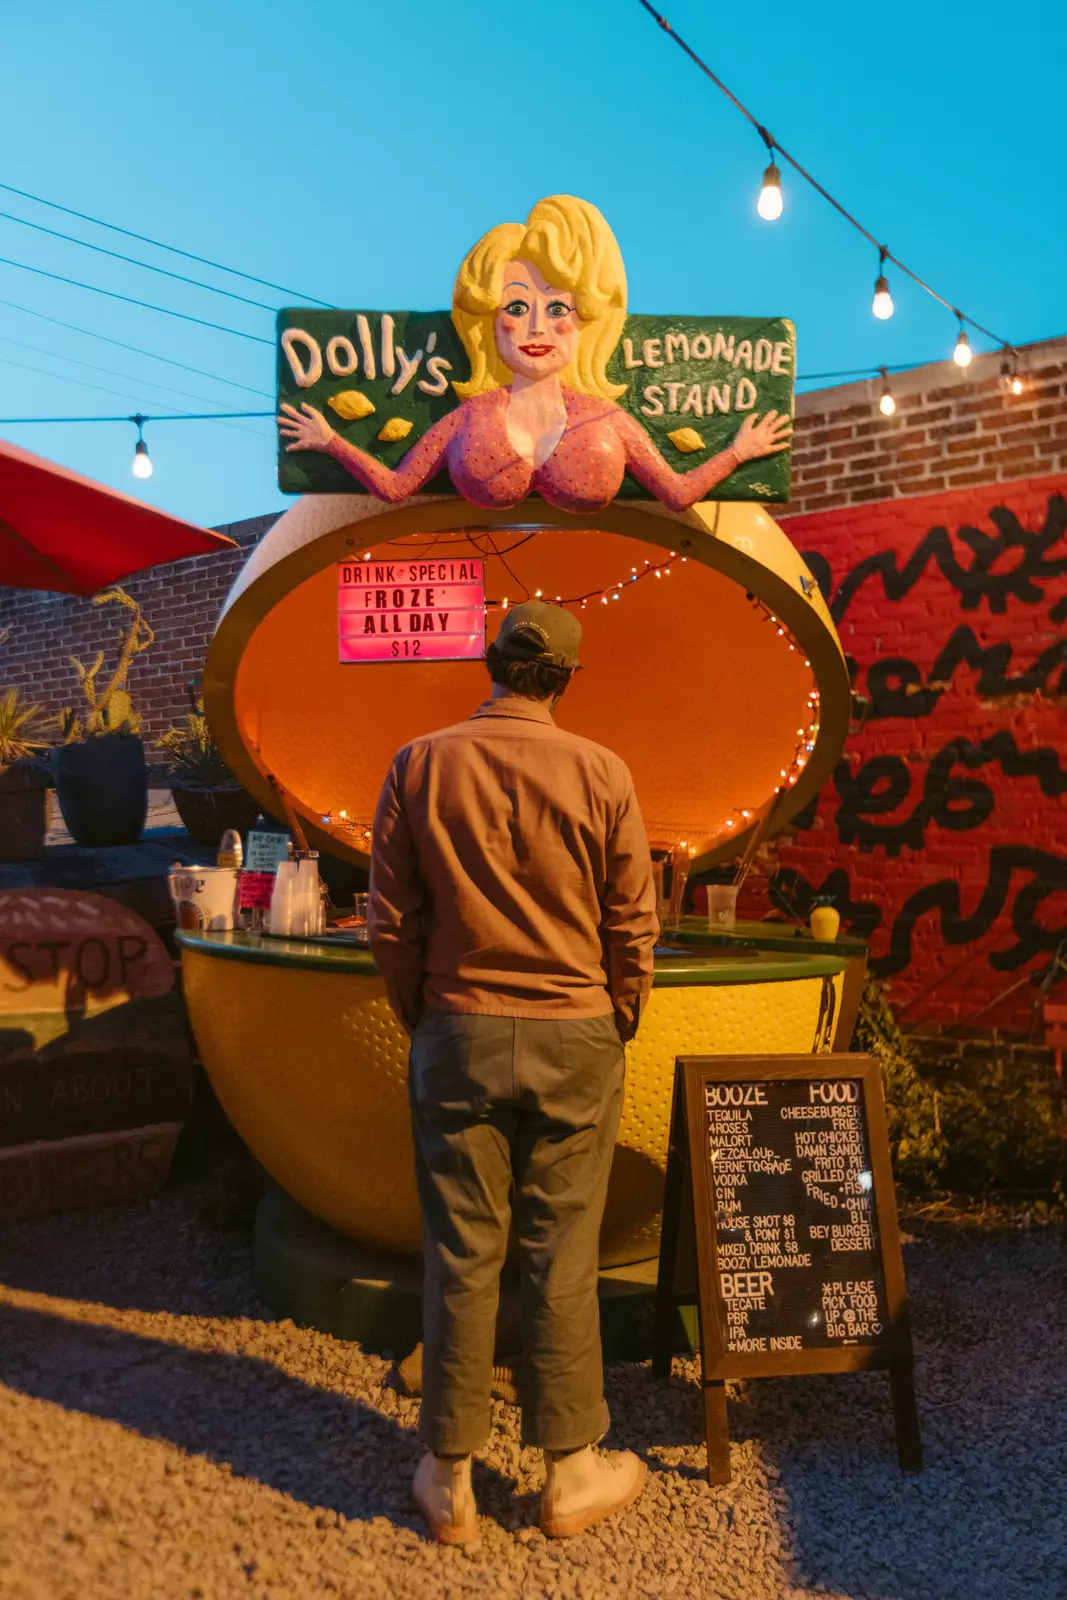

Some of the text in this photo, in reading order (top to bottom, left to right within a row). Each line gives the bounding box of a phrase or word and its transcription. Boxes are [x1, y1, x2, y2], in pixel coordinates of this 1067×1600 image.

[281, 314, 453, 396] Dolly's
[622, 332, 792, 376] LEMONADE
[640, 377, 757, 418] STAND
[343, 563, 478, 583] DRINK SPECIAL
[364, 613, 449, 634] ALL DAY
[391, 640, 421, 657] $12
[4, 935, 148, 993] STOP
[705, 1083, 769, 1107] BOOZE
[809, 1081, 859, 1104] FOOD
[706, 1109, 753, 1122] TEQUILA
[780, 1105, 862, 1120] CHEESEBURGER
[832, 1117, 863, 1131] FRIES
[709, 1134, 753, 1148] MALORT
[795, 1130, 864, 1144] HOT CHICKEN
[795, 1143, 865, 1158] DAMN SANDO
[814, 1156, 866, 1170] FRITO PIE
[712, 1174, 749, 1186] VODKA
[801, 1168, 845, 1183] GRILLED
[716, 1187, 735, 1199] GIN
[806, 1183, 839, 1209] FRIED
[717, 1200, 742, 1213] RUM
[716, 1216, 751, 1230] HOUSE
[752, 1214, 782, 1229] SHOT
[744, 1227, 796, 1242] & PONY $1
[831, 1223, 875, 1238] BURGER
[716, 1243, 747, 1257] MIXED
[749, 1241, 782, 1256] DRINK
[830, 1235, 877, 1252] DESSERT
[717, 1253, 812, 1271] BOOZY LEMONADE
[719, 1270, 775, 1299] BEER
[723, 1296, 767, 1311] TECATE
[821, 1294, 878, 1310] PICK FOOD
[726, 1311, 750, 1326] PBR
[825, 1309, 841, 1323] UP
[855, 1307, 879, 1322] THE
[728, 1325, 747, 1340] IPA
[826, 1323, 847, 1338] BIG
[769, 1335, 803, 1351] INSIDE
